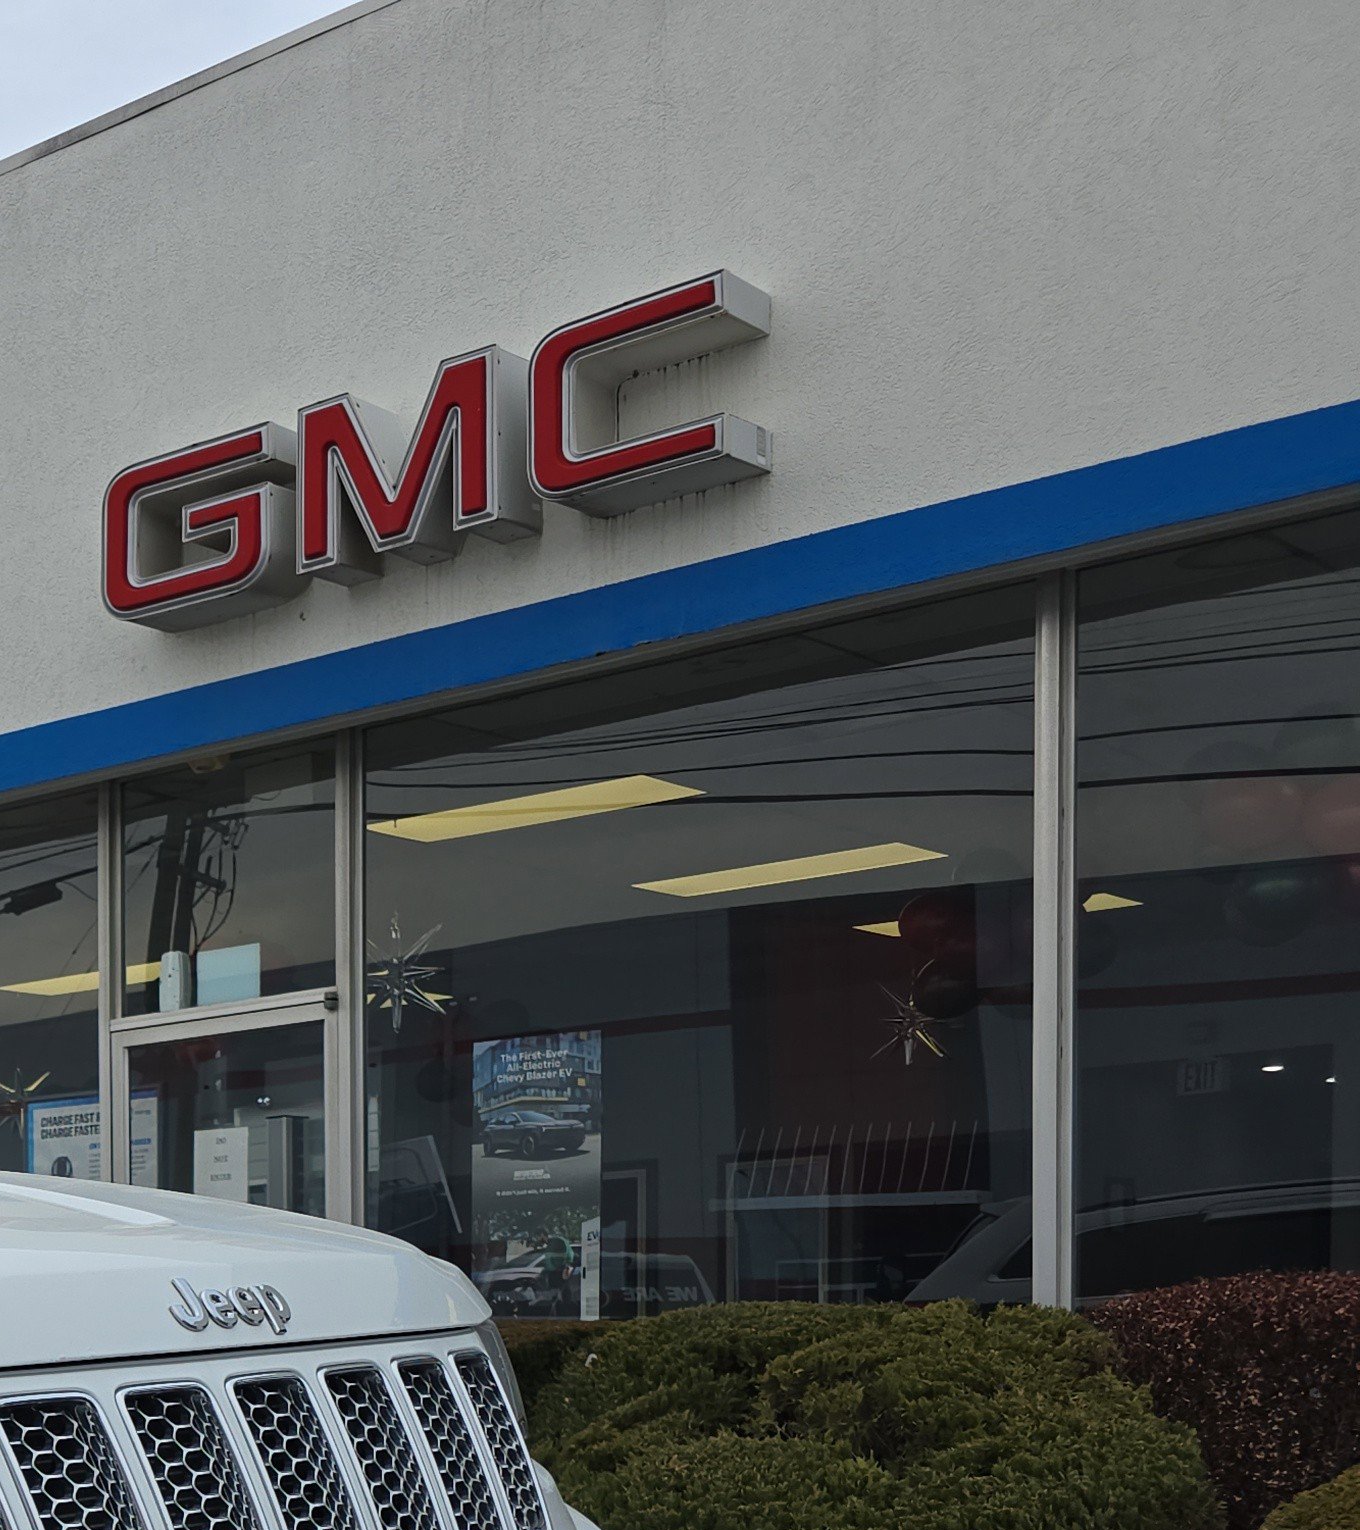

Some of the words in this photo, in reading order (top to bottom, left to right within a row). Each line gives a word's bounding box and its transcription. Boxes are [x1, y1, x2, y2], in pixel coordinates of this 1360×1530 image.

[102, 269, 740, 623] GMC
[500, 1054, 517, 1063] The
[519, 1049, 568, 1061] First-Ever
[506, 1060, 560, 1072] All-Electric
[497, 1073, 524, 1083] Chevy
[526, 1070, 557, 1081] Blazer
[559, 1068, 573, 1078] EV
[1184, 1060, 1217, 1092] EXIT
[41, 1114, 73, 1127] CHARGE
[74, 1112, 95, 1124] FAST
[41, 1126, 73, 1140] CHARGE
[74, 1125, 101, 1137] FASTE
[169, 1277, 292, 1335] Jeep
